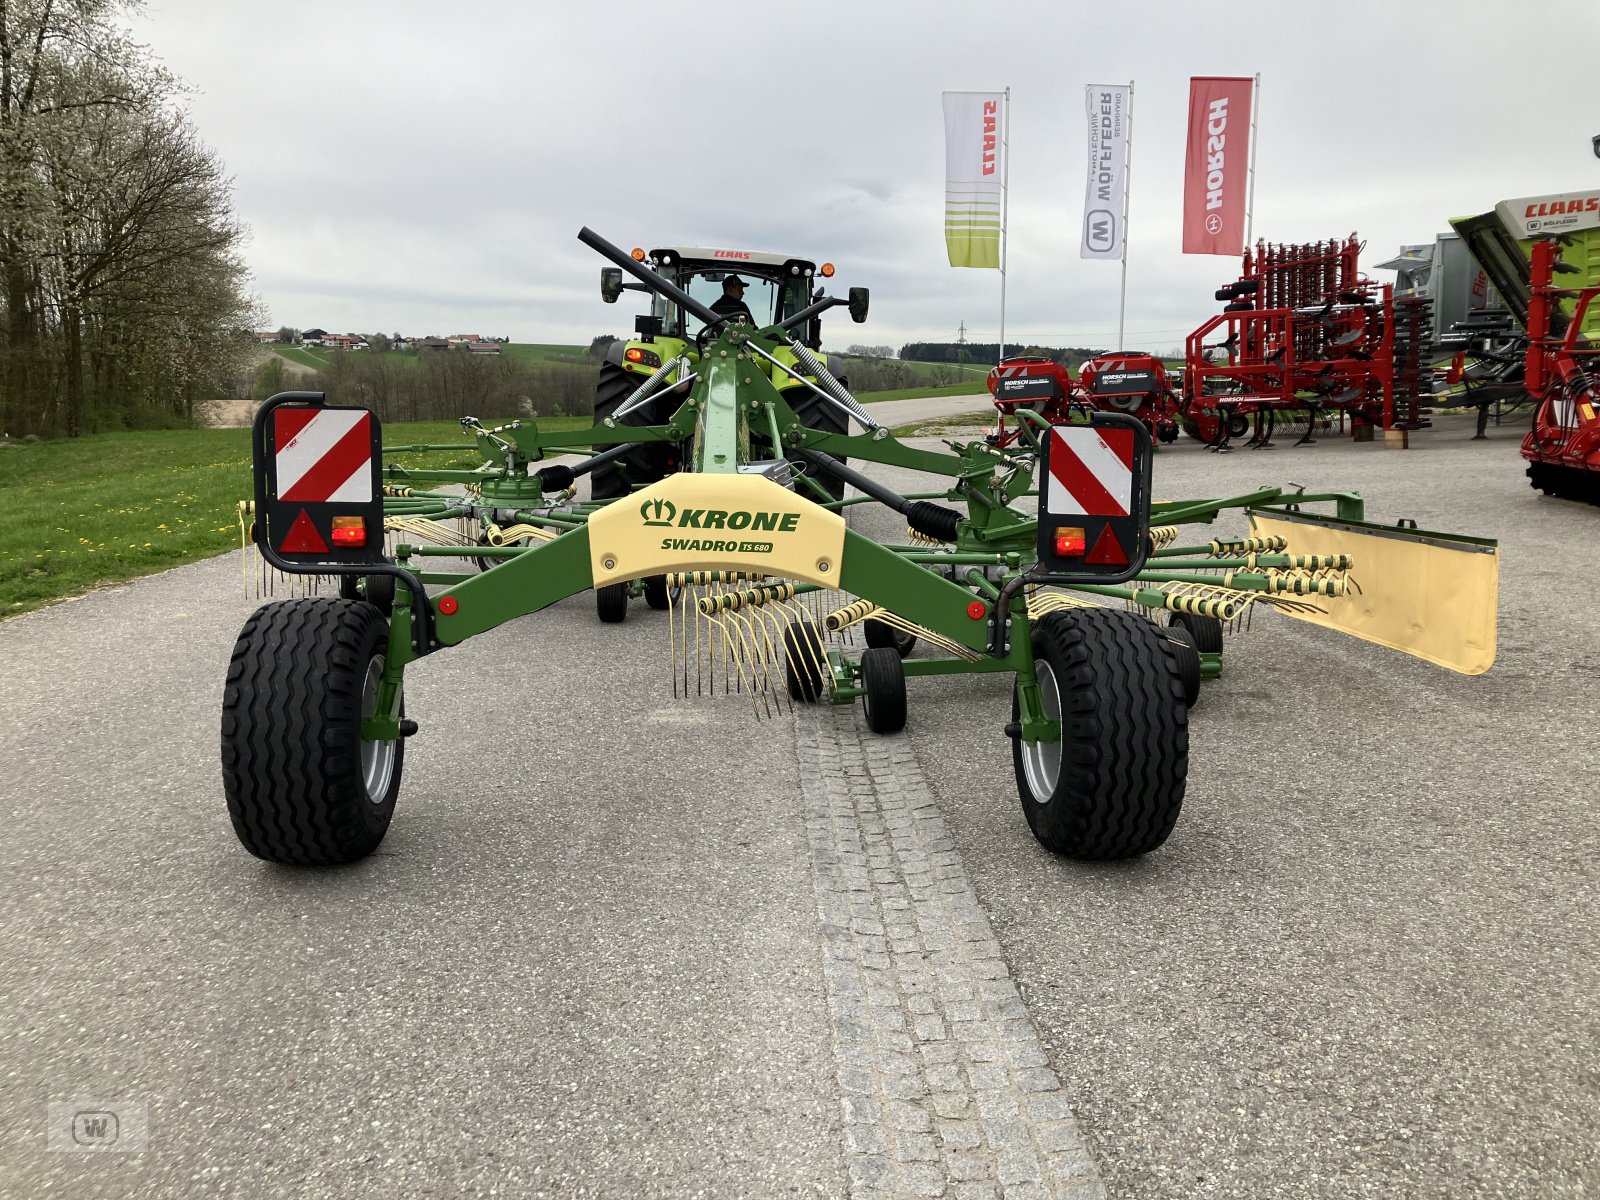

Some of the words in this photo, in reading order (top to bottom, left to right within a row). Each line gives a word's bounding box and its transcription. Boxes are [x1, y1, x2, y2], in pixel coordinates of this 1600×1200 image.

[1525, 198, 1599, 218] CLAAS
[713, 250, 750, 260] CLAAS
[678, 509, 801, 532] KRONE
[661, 538, 738, 552] SWADRO
[741, 543, 753, 551] TS
[754, 544, 770, 552] 680
